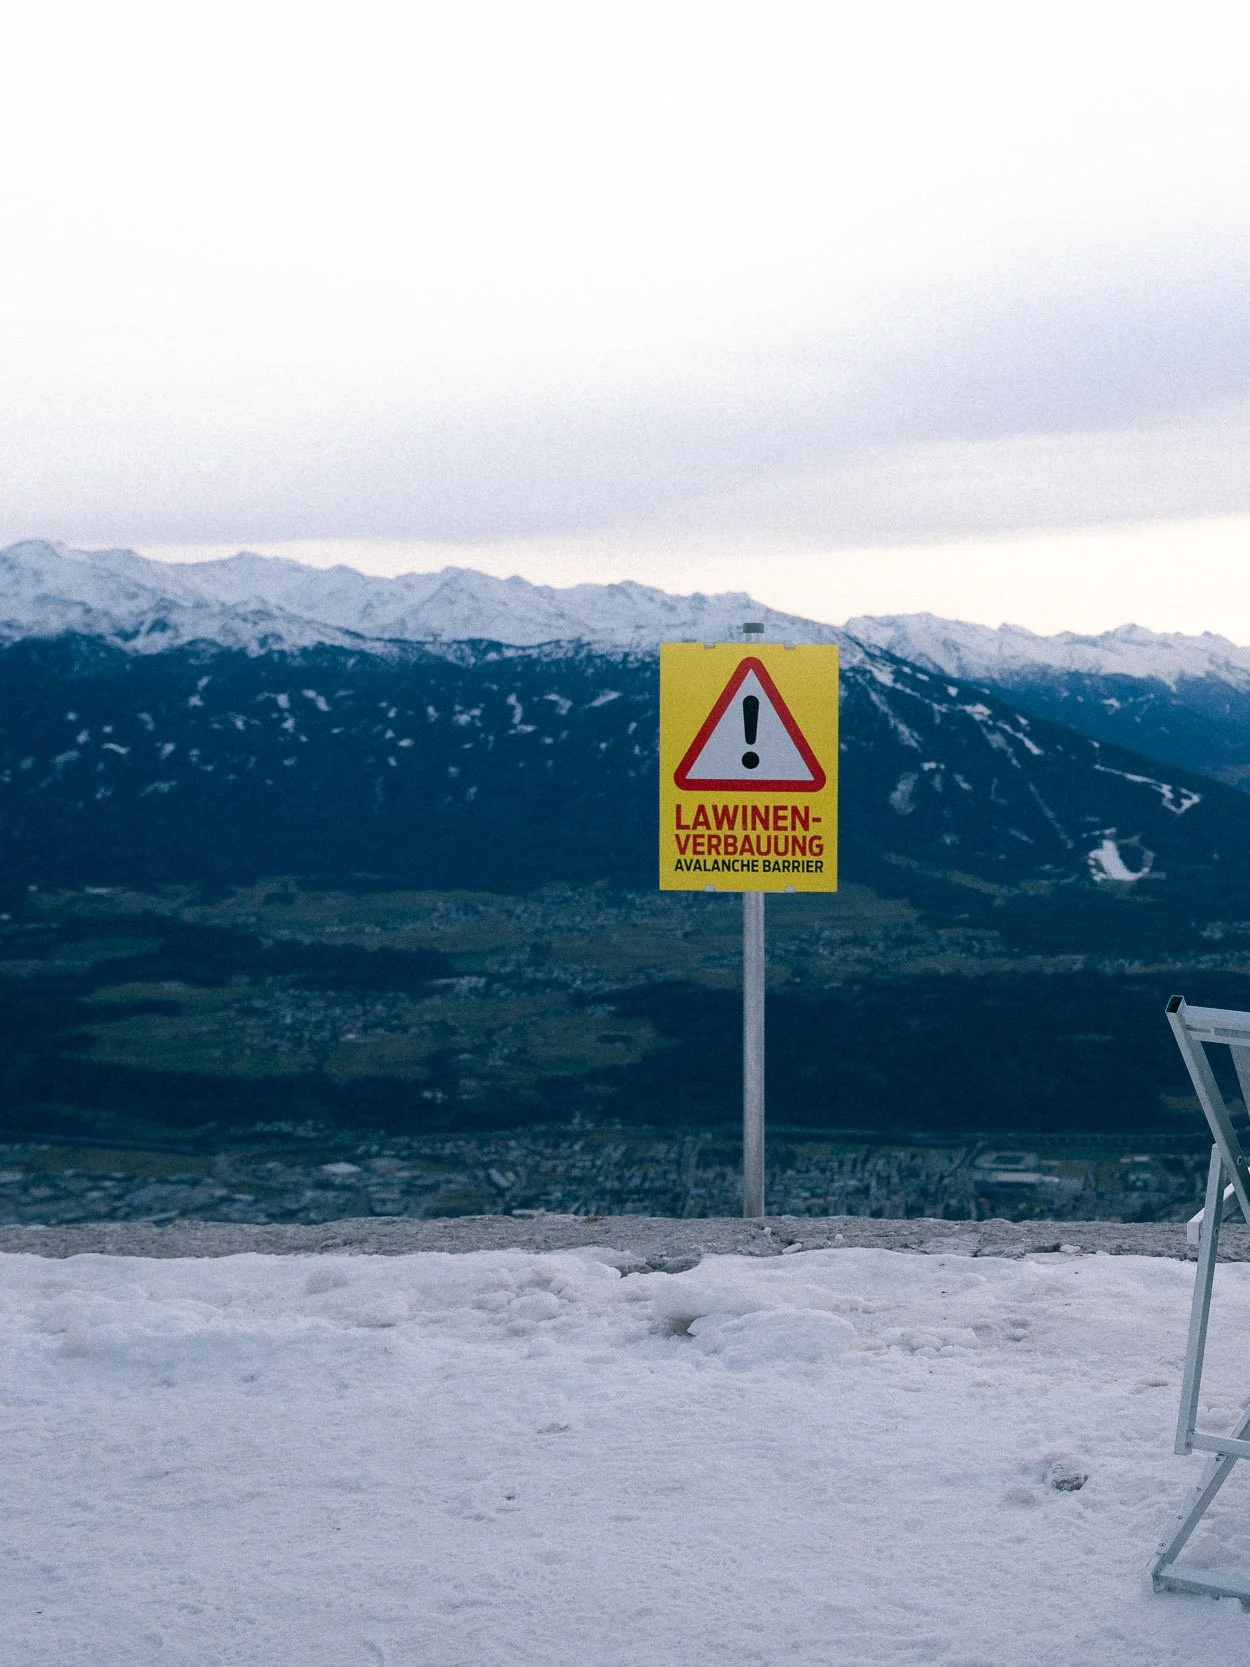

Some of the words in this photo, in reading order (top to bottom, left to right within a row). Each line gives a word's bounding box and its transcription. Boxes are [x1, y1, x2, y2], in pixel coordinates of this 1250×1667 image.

[675, 804, 822, 832] LAWINEN-
[675, 834, 824, 857] VERBAUUNG
[674, 859, 759, 872] AVALANCHE
[762, 860, 824, 873] BARRIER
